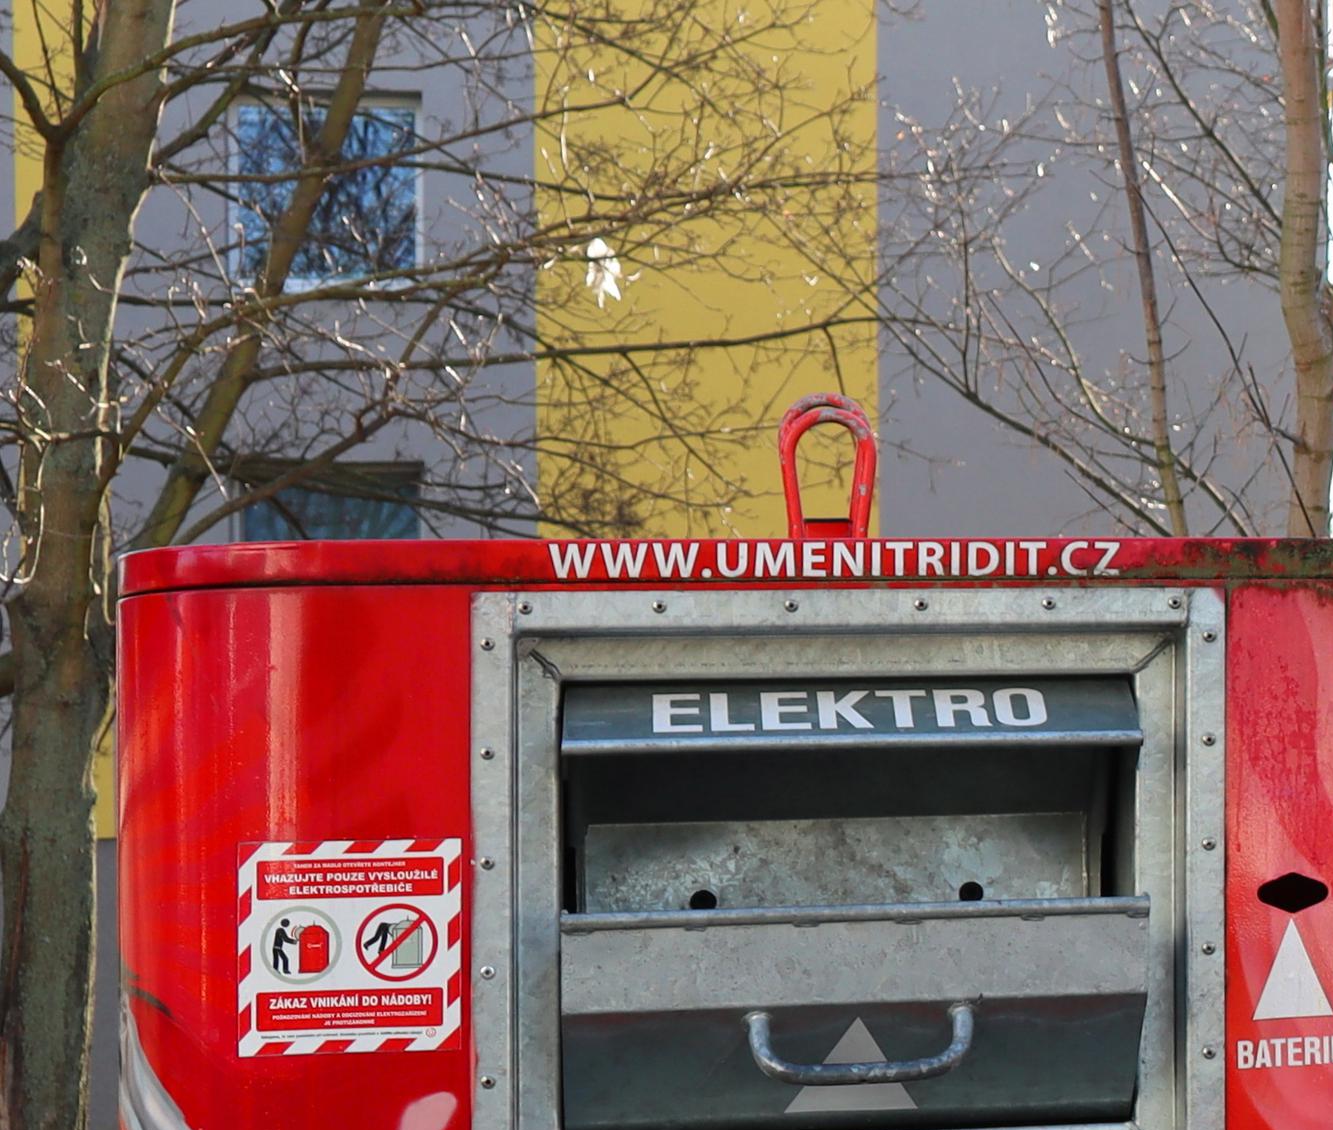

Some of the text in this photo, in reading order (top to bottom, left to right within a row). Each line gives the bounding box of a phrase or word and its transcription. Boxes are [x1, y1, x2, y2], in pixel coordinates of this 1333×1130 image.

[548, 541, 1122, 579] WWW.UMENITRIDIT.CZ
[651, 687, 1049, 733] ELEKTRO
[264, 869, 438, 884] VHAZUJTE POUZE VYSLOUŽILÉ
[289, 883, 413, 895] ELEKTROSPOTŘEBIČE
[269, 993, 432, 1009] ZÁKAZ VNIKÁNÍ DO NÁDOBY!
